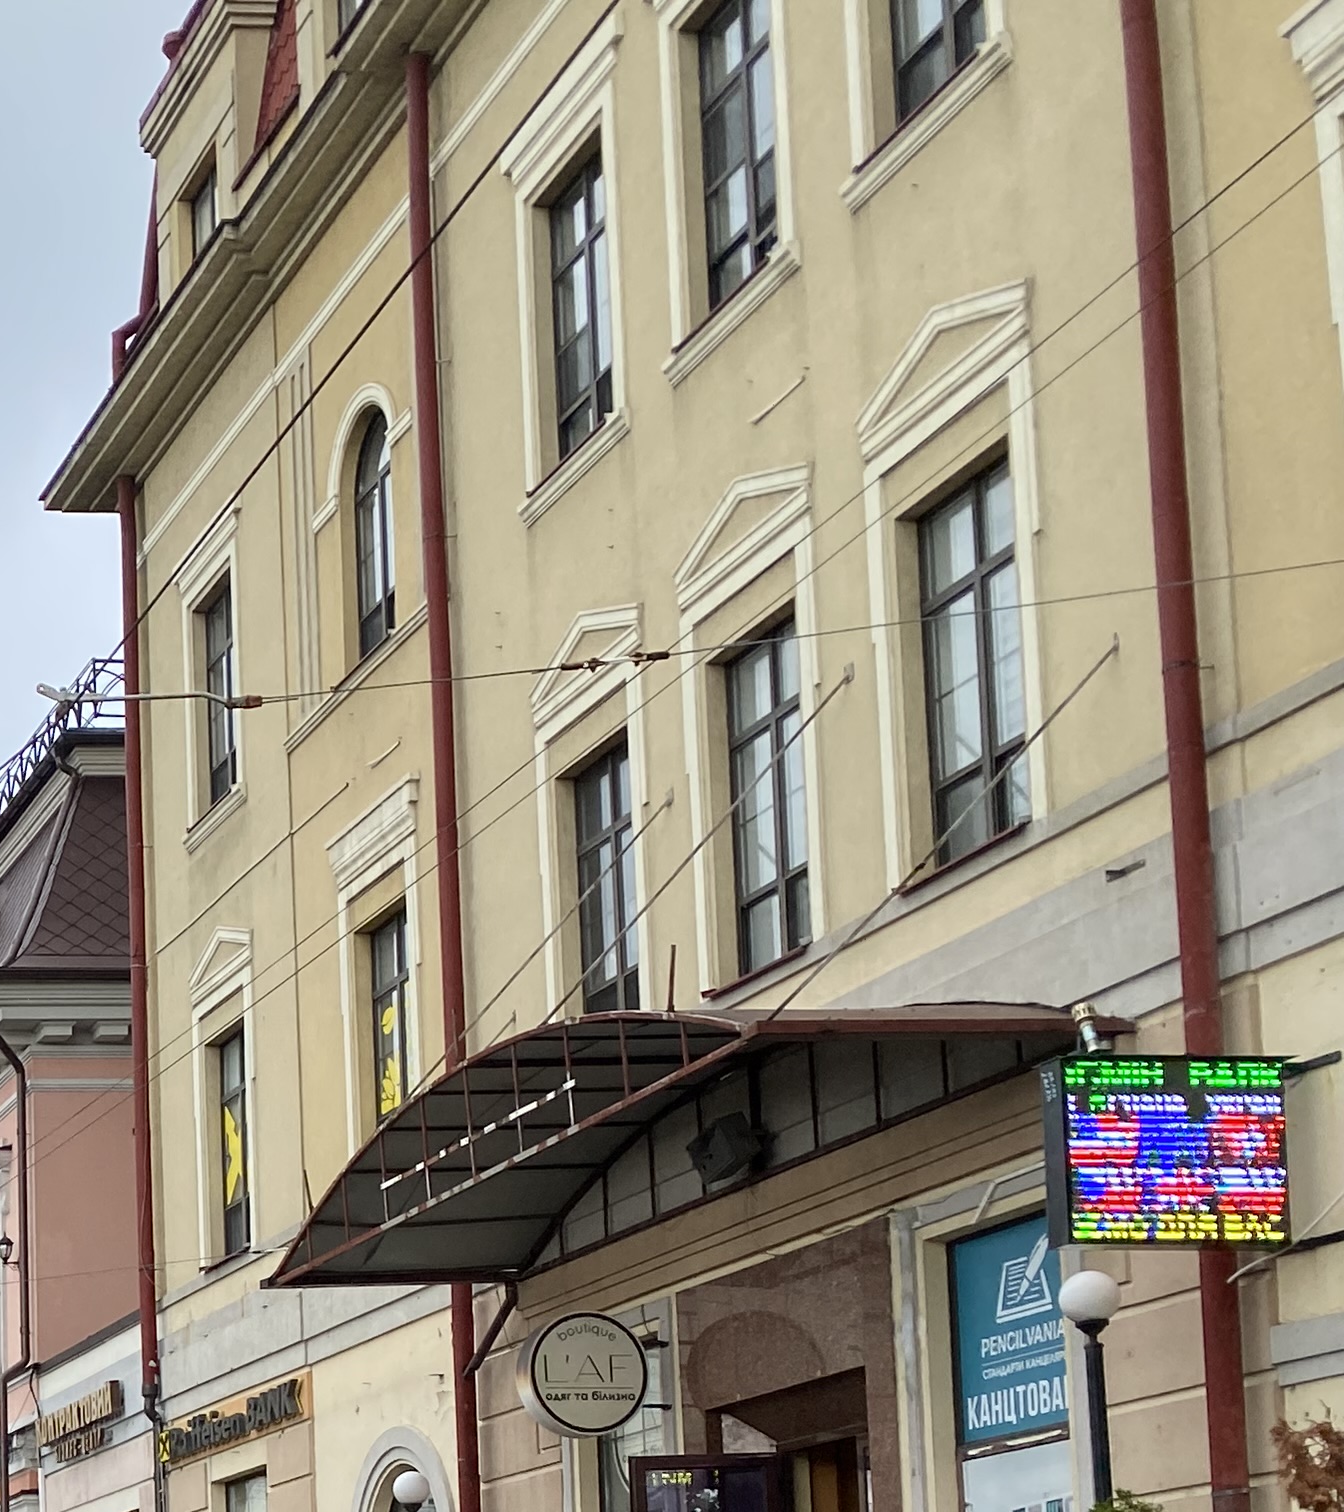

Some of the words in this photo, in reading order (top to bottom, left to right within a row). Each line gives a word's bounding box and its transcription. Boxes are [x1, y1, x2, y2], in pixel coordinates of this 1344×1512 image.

[557, 1322, 617, 1341] boutique
[981, 1318, 1065, 1358] PENCILVANIA
[544, 1354, 632, 1383] L'AF
[246, 1379, 300, 1436] BANK
[545, 1392, 571, 1401] одяг
[574, 1392, 588, 1401] та
[591, 1391, 636, 1401] білизна
